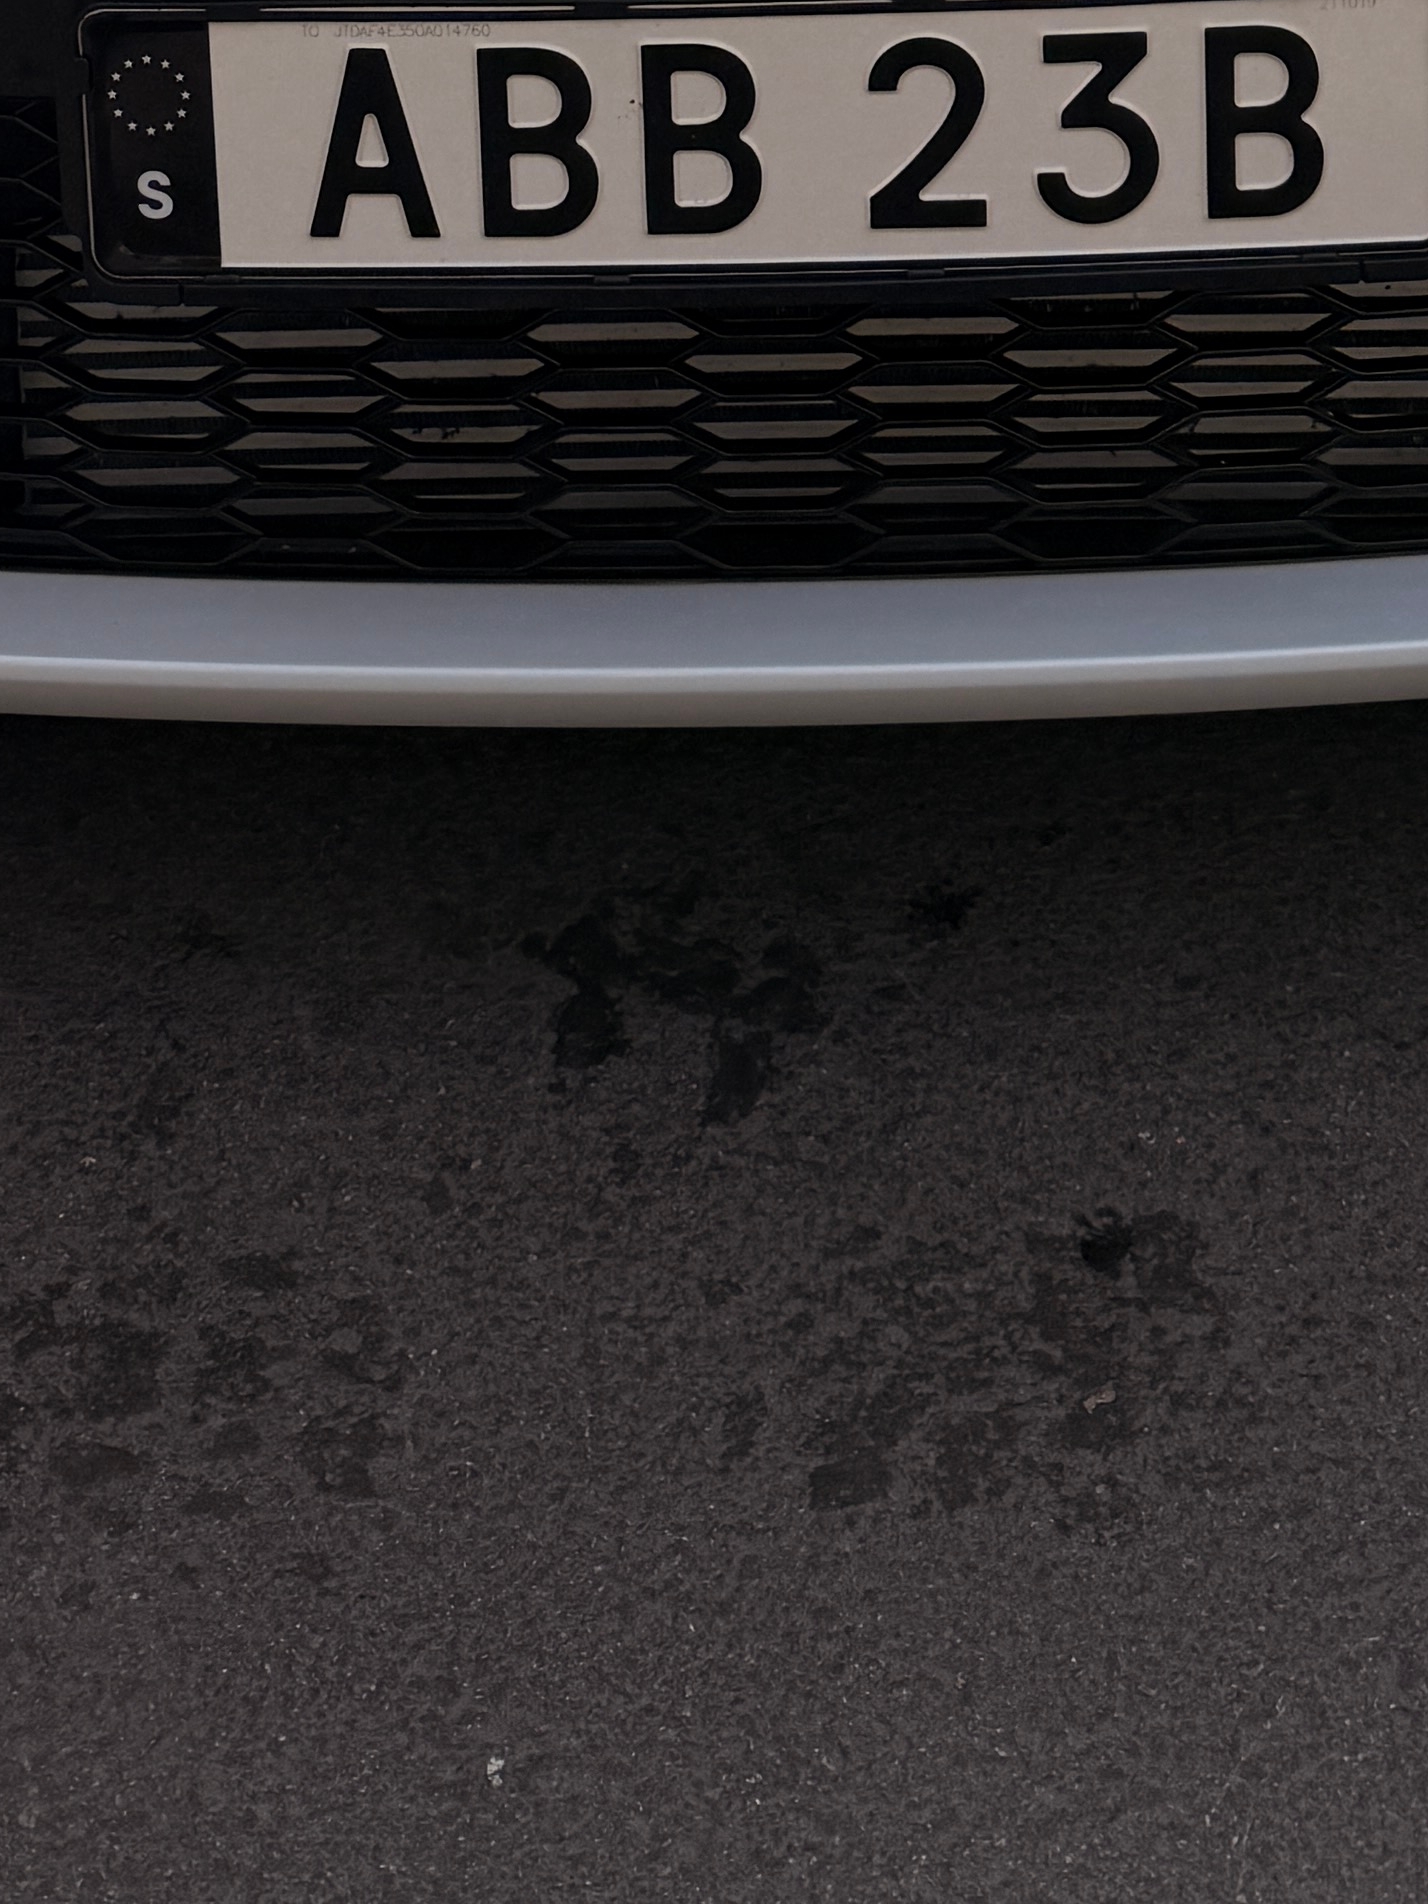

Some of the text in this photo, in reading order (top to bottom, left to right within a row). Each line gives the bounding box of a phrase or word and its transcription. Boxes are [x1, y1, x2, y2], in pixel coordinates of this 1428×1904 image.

[137, 170, 173, 219] S
[309, 25, 1324, 238] ABB 23B
